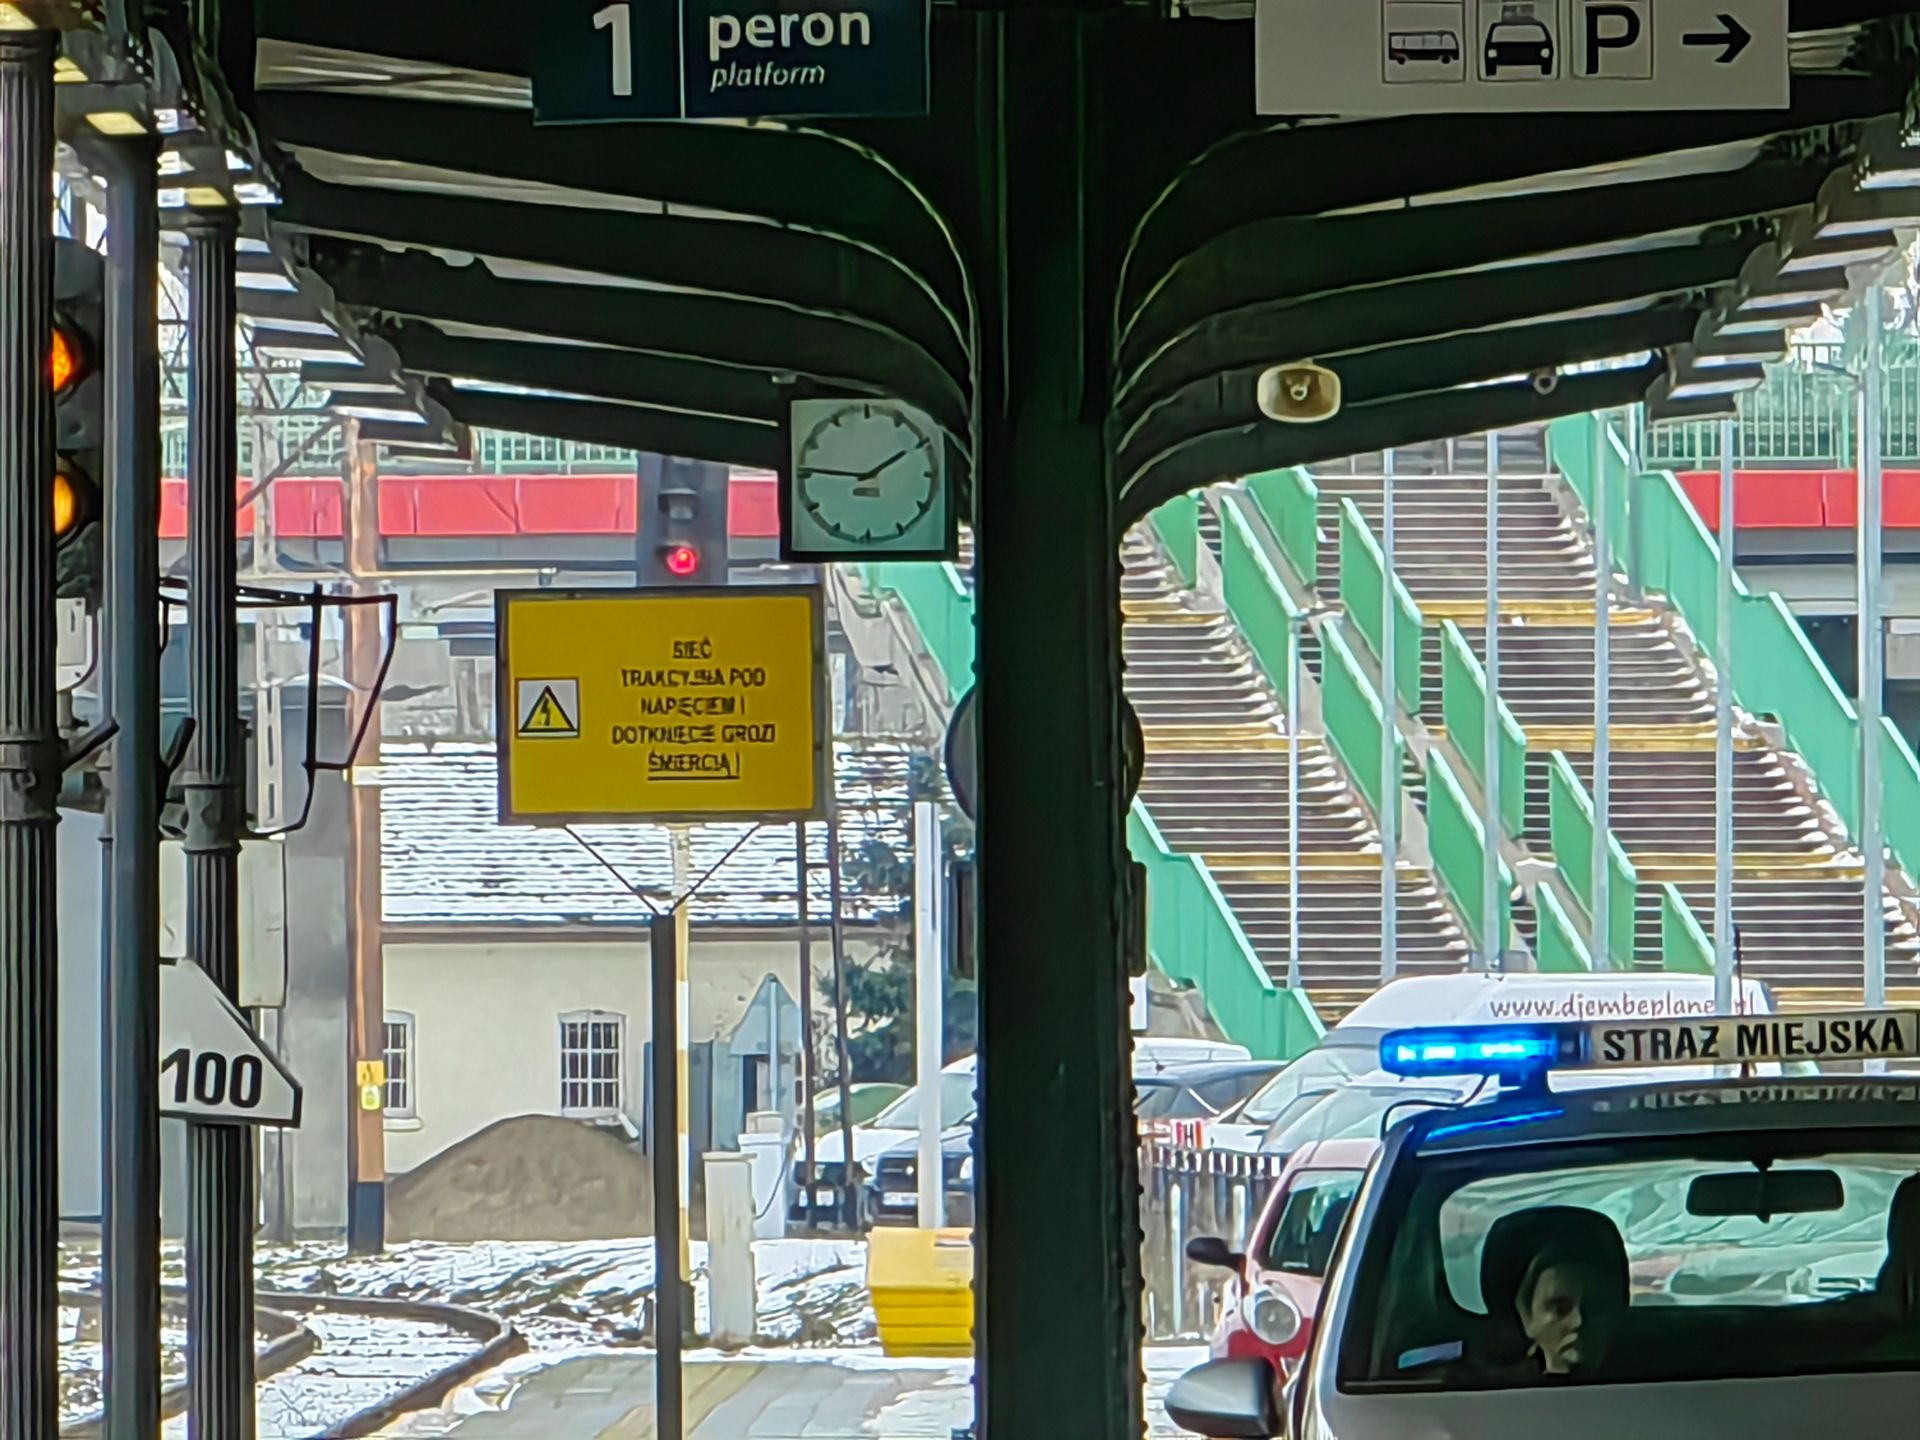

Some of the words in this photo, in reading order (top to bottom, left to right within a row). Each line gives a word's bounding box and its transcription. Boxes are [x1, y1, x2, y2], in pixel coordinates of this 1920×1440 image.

[593, 3, 632, 96] 1
[708, 11, 871, 61] peron
[710, 61, 826, 93] platform
[729, 667, 766, 687] POD
[1736, 1017, 1905, 1057] MIEJSKA
[161, 1048, 262, 1108] 100
